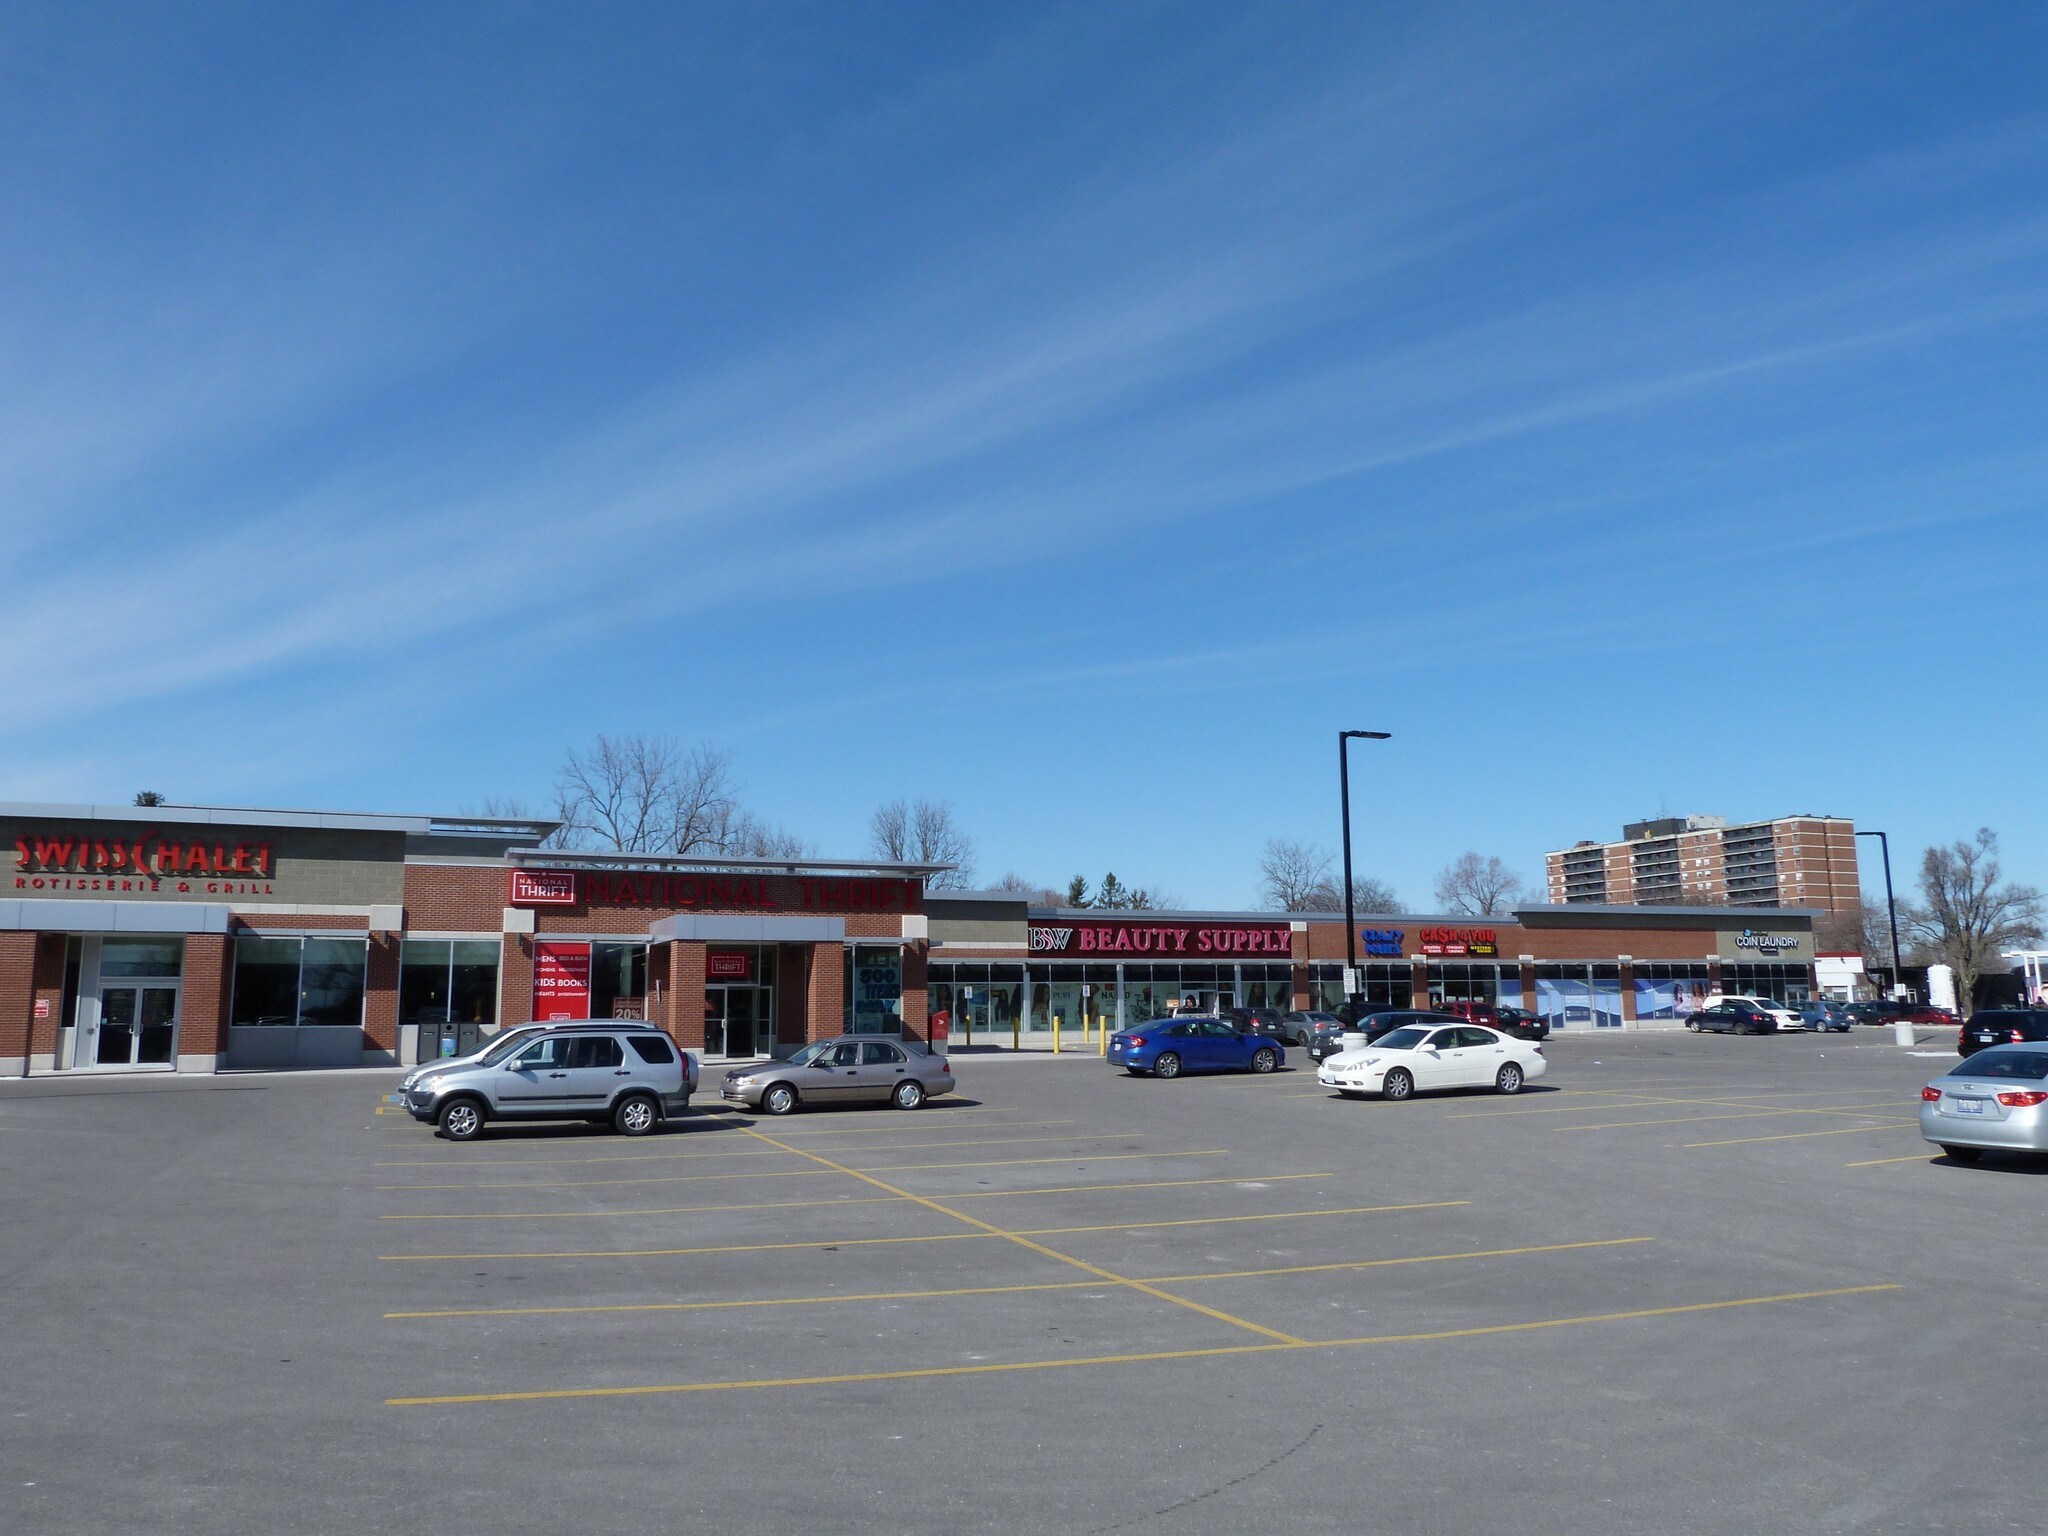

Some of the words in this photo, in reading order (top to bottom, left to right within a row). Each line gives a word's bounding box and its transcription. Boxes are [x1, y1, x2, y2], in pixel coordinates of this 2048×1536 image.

[15, 833, 128, 868] SWISS
[15, 876, 160, 892] ROTISSERIE
[177, 881, 190, 893] &
[205, 882, 274, 895] GRILL
[519, 878, 568, 886] NATIONAL
[519, 885, 568, 897] THRIFT
[585, 875, 776, 907] NATIONAL
[798, 877, 921, 909] THRIFT
[1078, 928, 1191, 951] BEAUTY
[1197, 929, 1293, 951] SUPPLY
[1470, 929, 1496, 942] YOU
[1736, 936, 1758, 946] COIN
[1760, 937, 1798, 947] LAUNDRY
[535, 955, 556, 963] MENS
[714, 963, 742, 971] THRIFT
[859, 968, 896, 984] 500
[534, 978, 556, 987] KIDS
[557, 979, 588, 987] BOOKS
[1101, 991, 1130, 999] NAD
[615, 1008, 640, 1019] 20%
